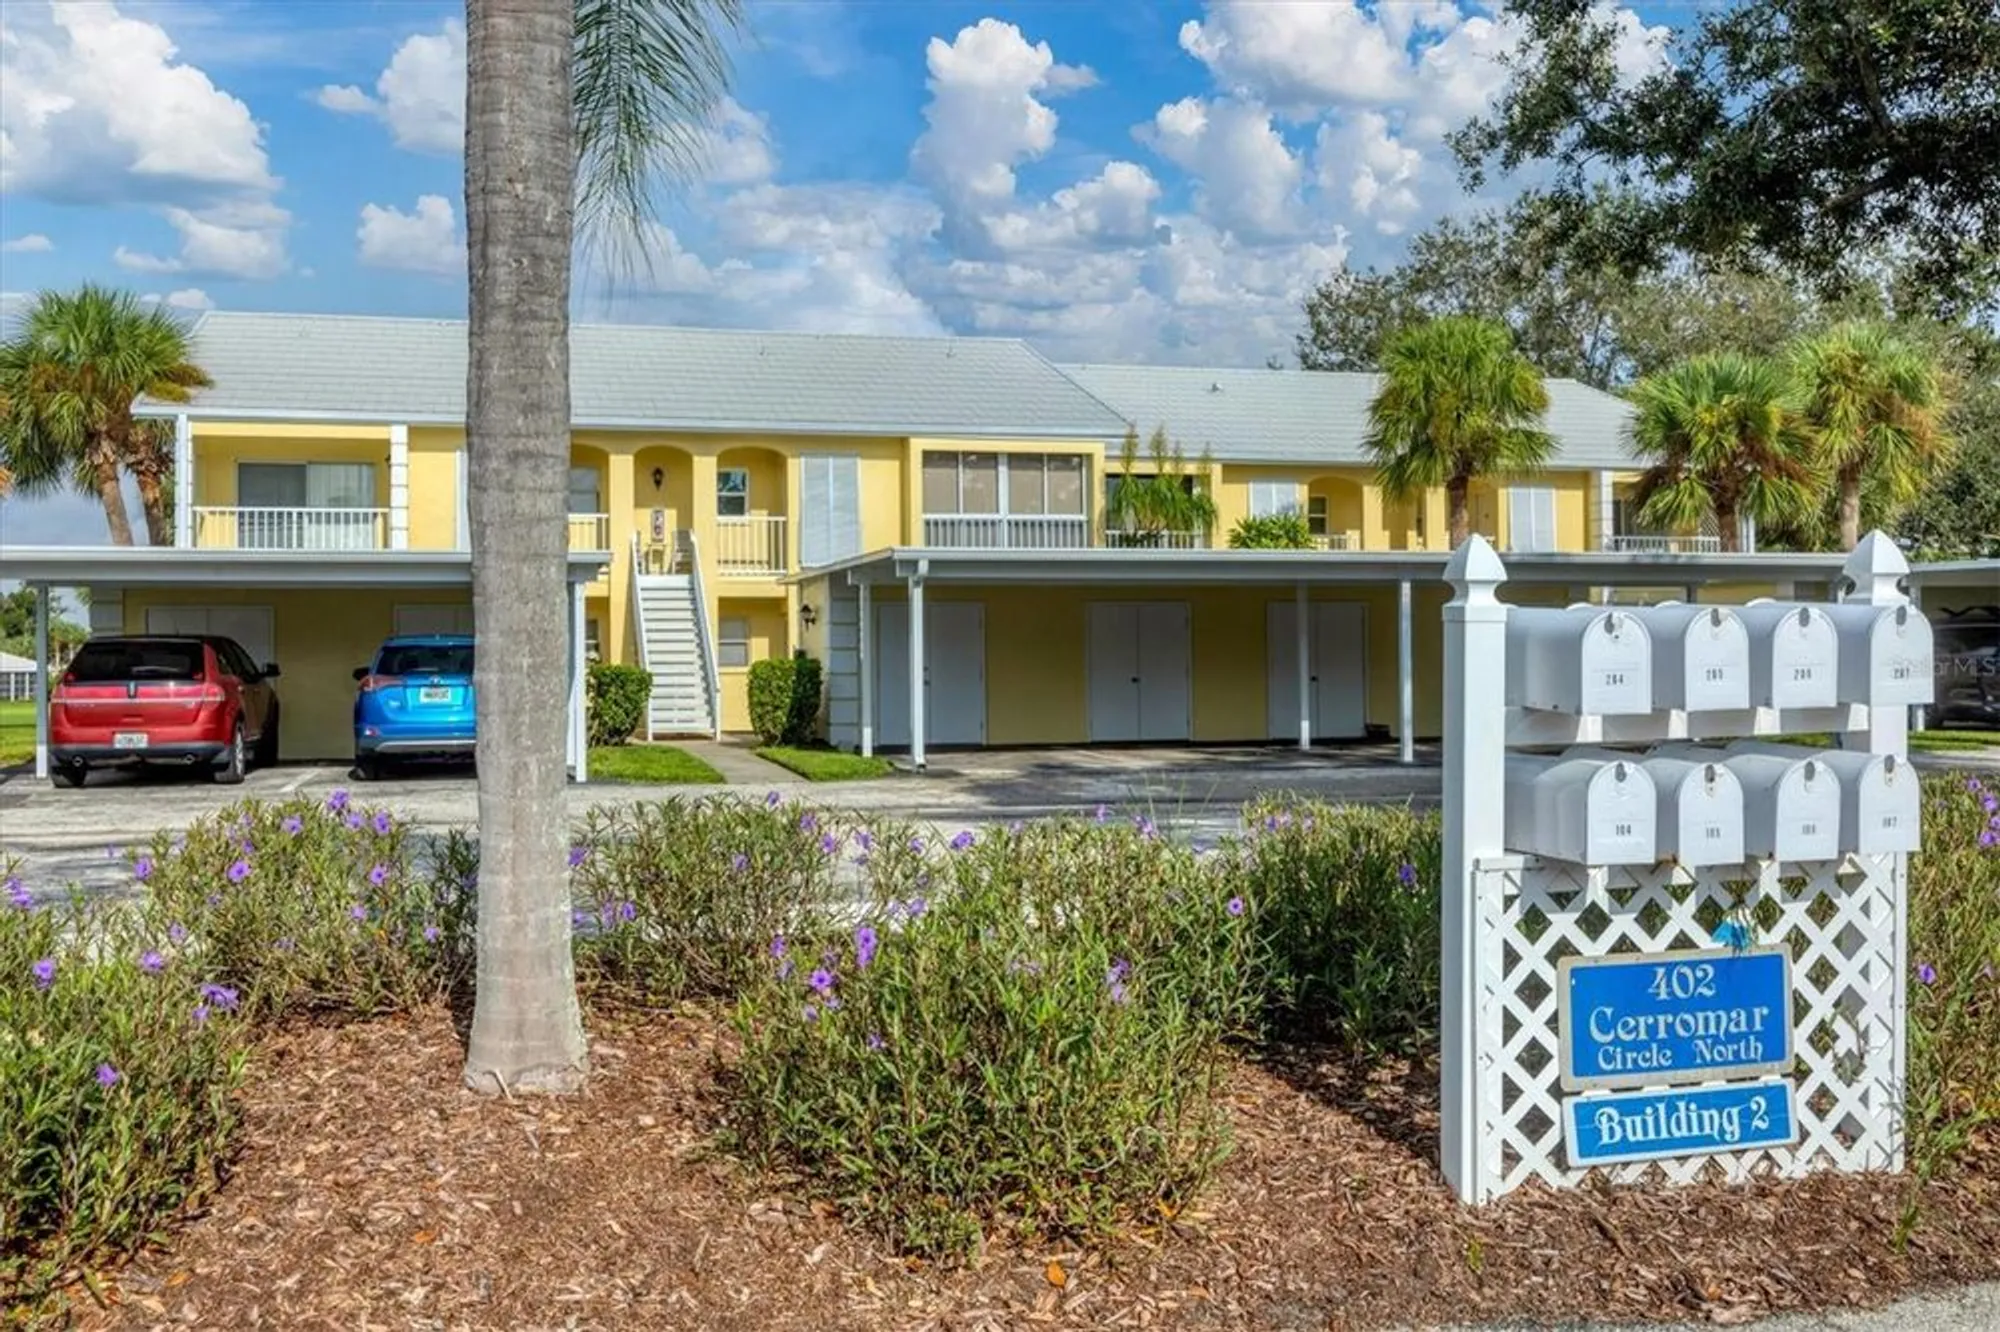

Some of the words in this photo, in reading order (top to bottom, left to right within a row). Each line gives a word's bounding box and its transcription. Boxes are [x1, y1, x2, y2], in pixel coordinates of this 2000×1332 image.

[1648, 964, 1716, 1001] 402
[1589, 1005, 1769, 1043] Cerromar
[1597, 1043, 1673, 1071] Circle
[1693, 1035, 1763, 1064] North
[1594, 1100, 1743, 1146] Building
[1749, 1095, 1770, 1131] 2
